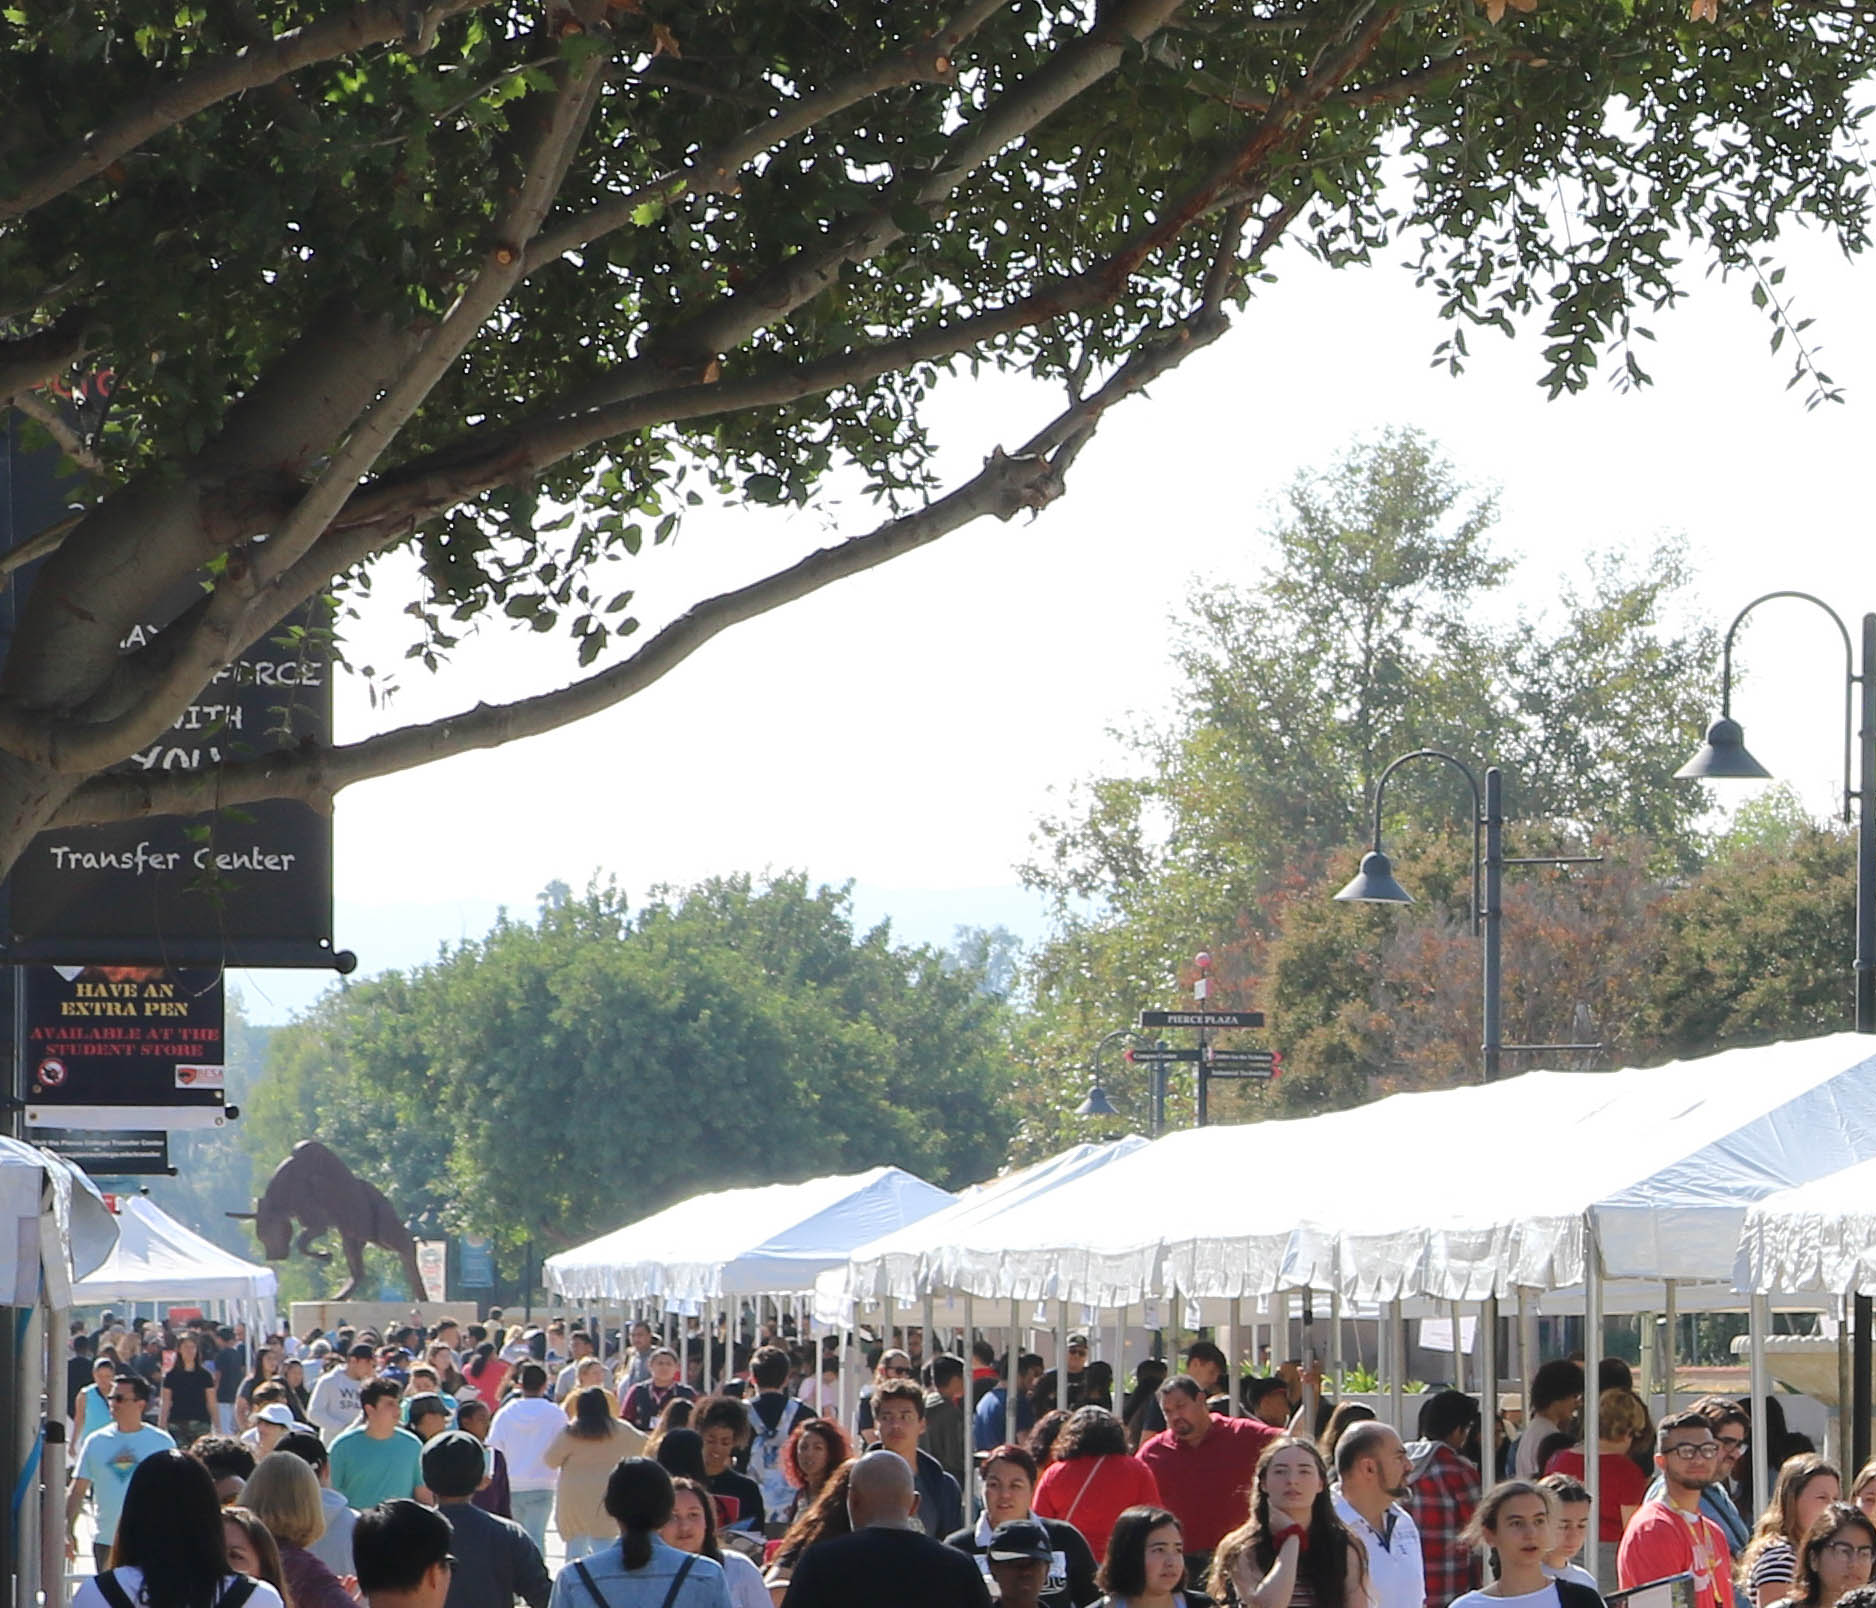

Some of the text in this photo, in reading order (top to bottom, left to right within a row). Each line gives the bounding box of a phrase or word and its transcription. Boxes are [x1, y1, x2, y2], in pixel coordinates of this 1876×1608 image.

[50, 842, 296, 875] Transfer Center
[75, 983, 175, 998] HAVE AN
[60, 1002, 189, 1016] EXTRA PEN
[1167, 1015, 1239, 1024] PIERCE PLAZA
[30, 1026, 220, 1042] AVAILABLE AT THE
[46, 1043, 204, 1057] STUDENT STORE
